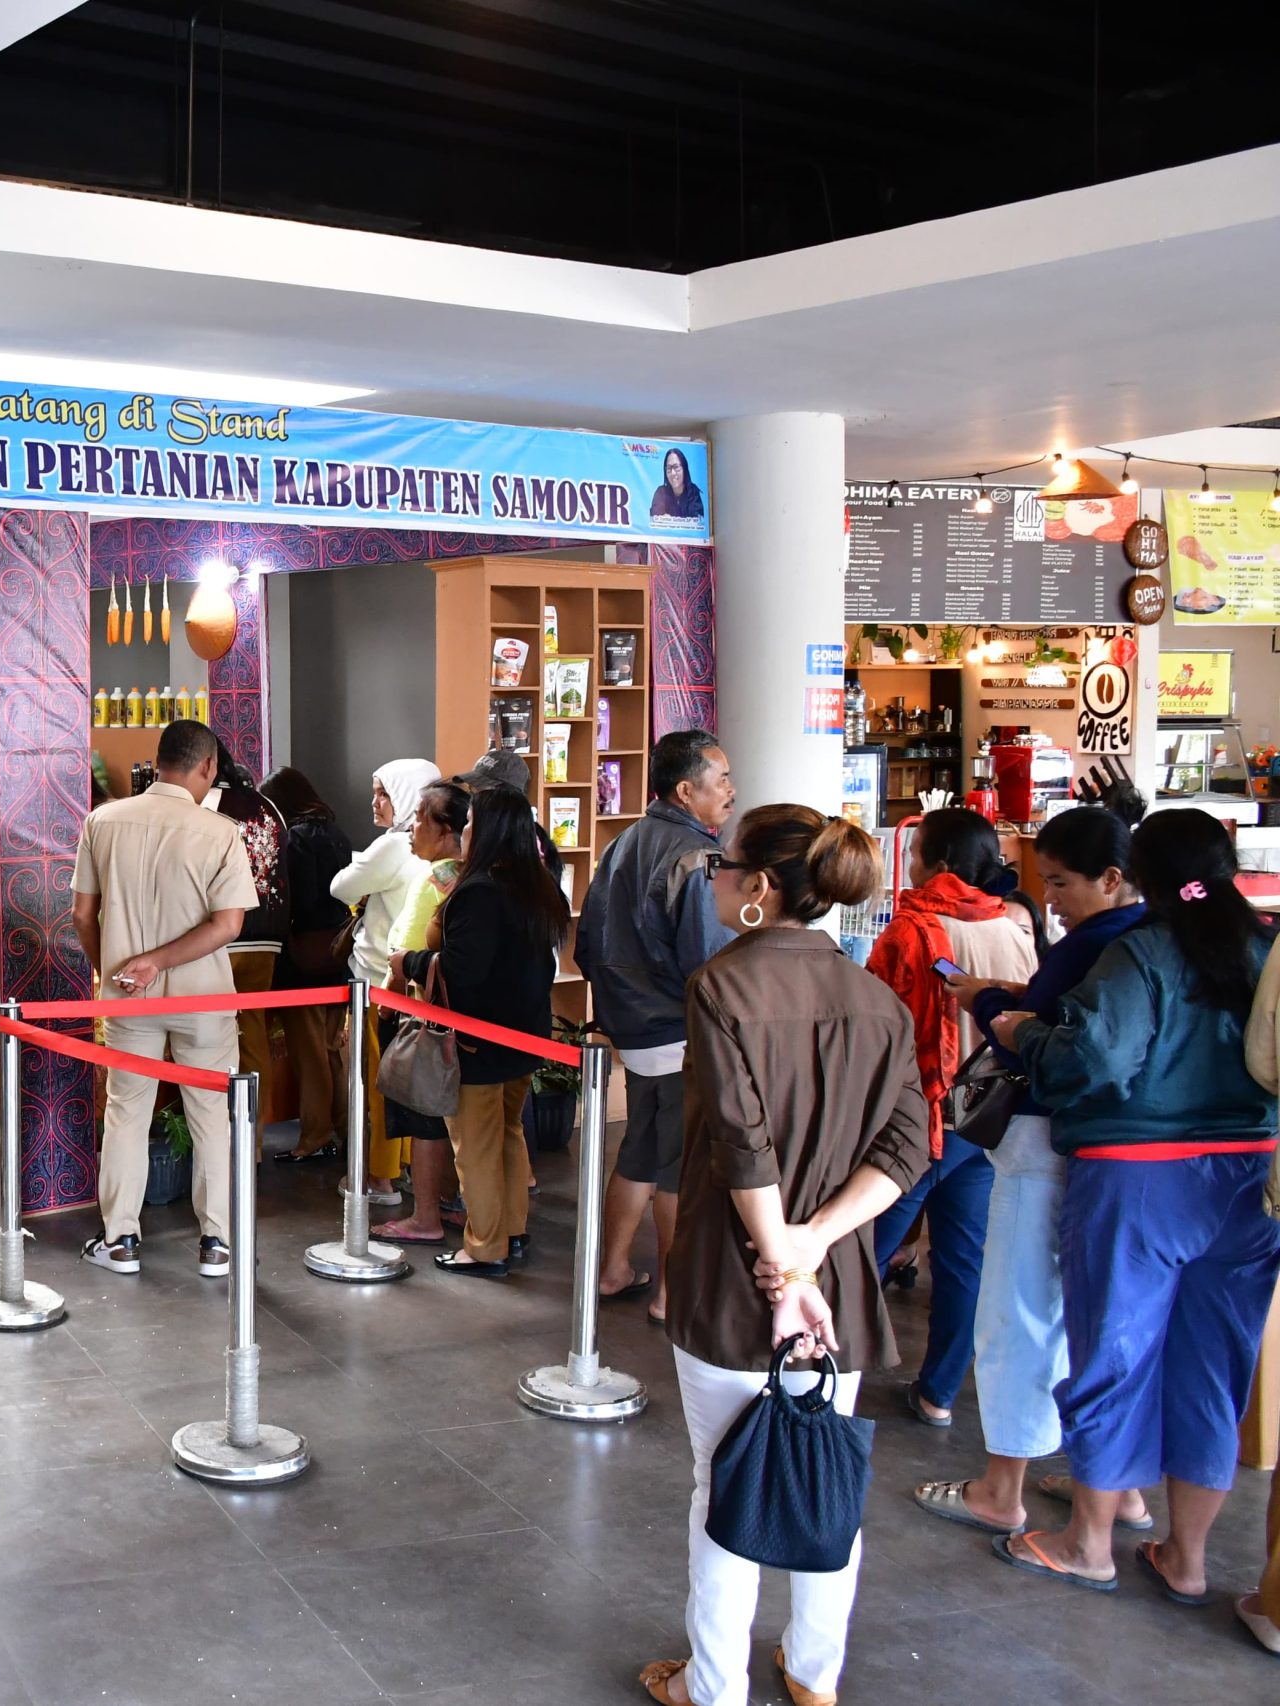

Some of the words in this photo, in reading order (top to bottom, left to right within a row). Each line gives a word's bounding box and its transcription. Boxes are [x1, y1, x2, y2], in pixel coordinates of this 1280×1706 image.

[118, 394, 156, 431] di
[167, 398, 290, 445] Stand
[23, 441, 260, 503] PERTANIAN
[272, 459, 481, 515] KABUPATEN
[491, 475, 631, 526] SAMOSIR
[908, 487, 985, 500] EATERY
[1140, 526, 1158, 537] GO
[1141, 539, 1157, 550] HI
[1135, 586, 1164, 604] OPEN
[1077, 710, 1130, 751] COFFEE
